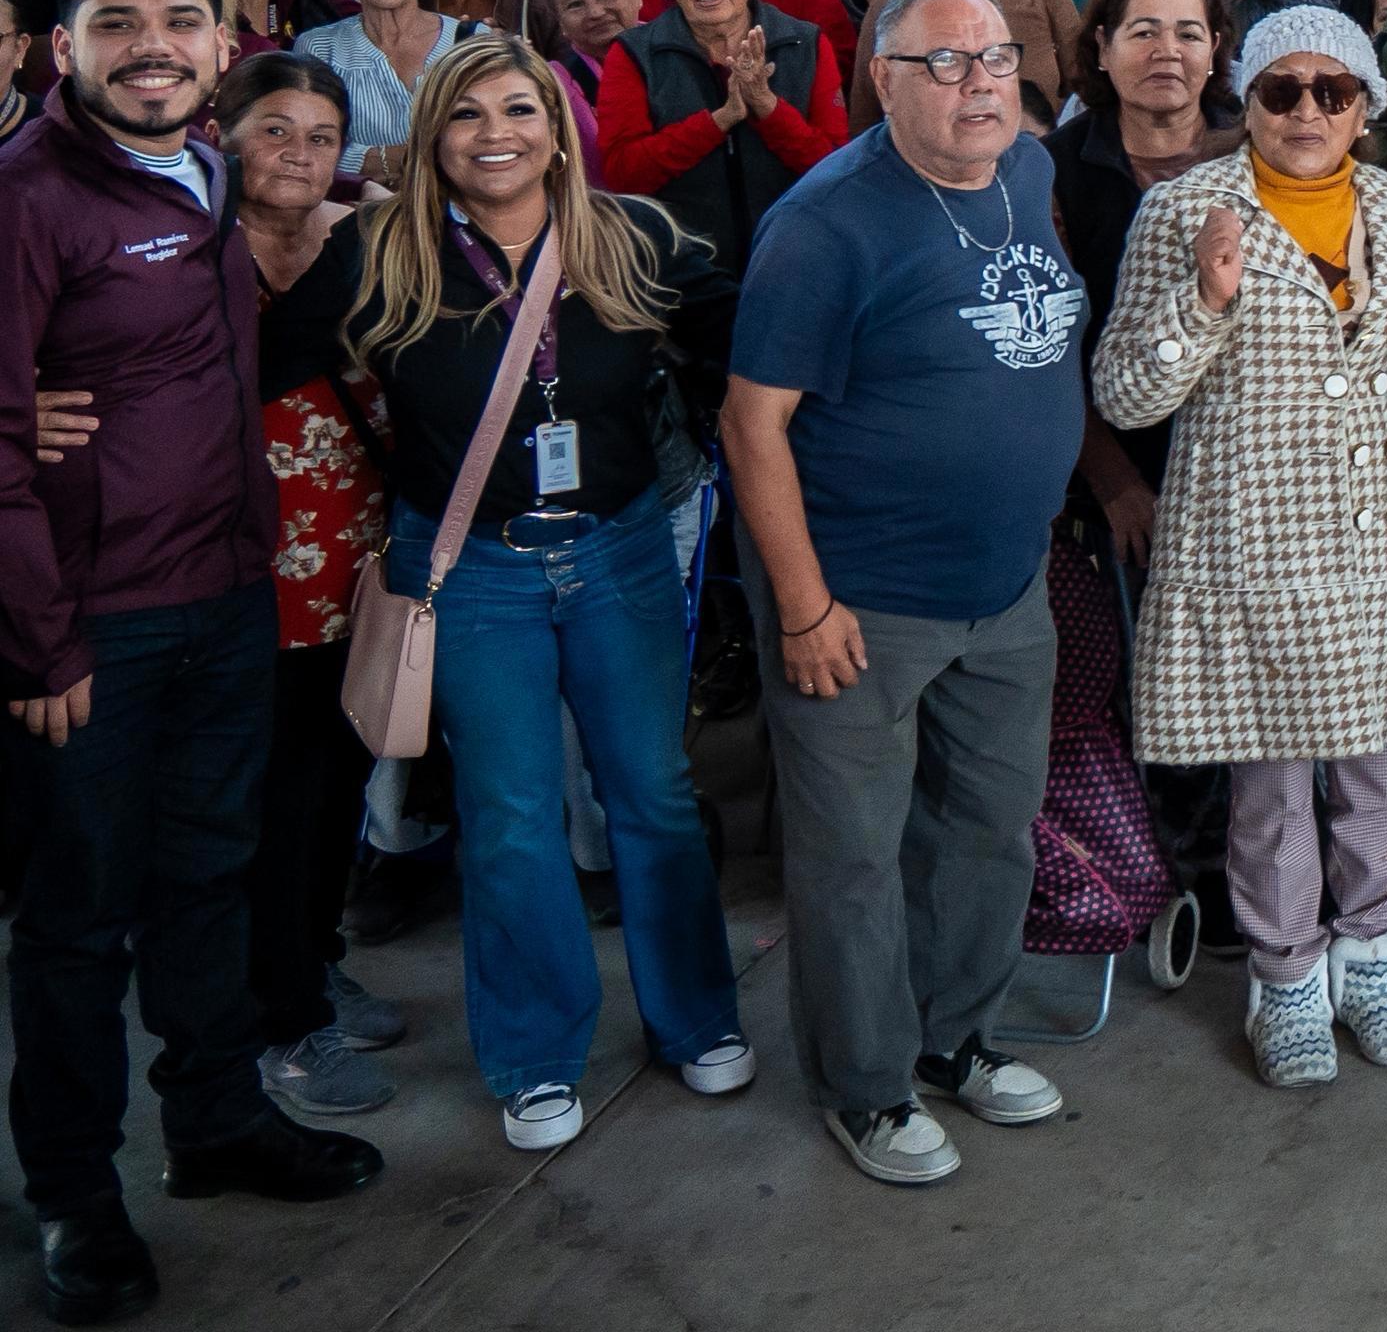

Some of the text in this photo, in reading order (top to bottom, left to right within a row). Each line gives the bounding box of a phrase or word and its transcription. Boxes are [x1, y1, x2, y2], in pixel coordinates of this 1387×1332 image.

[145, 248, 178, 263] Regidor
[980, 243, 1069, 301] DOCKERS
[1016, 352, 1034, 363] EST.
